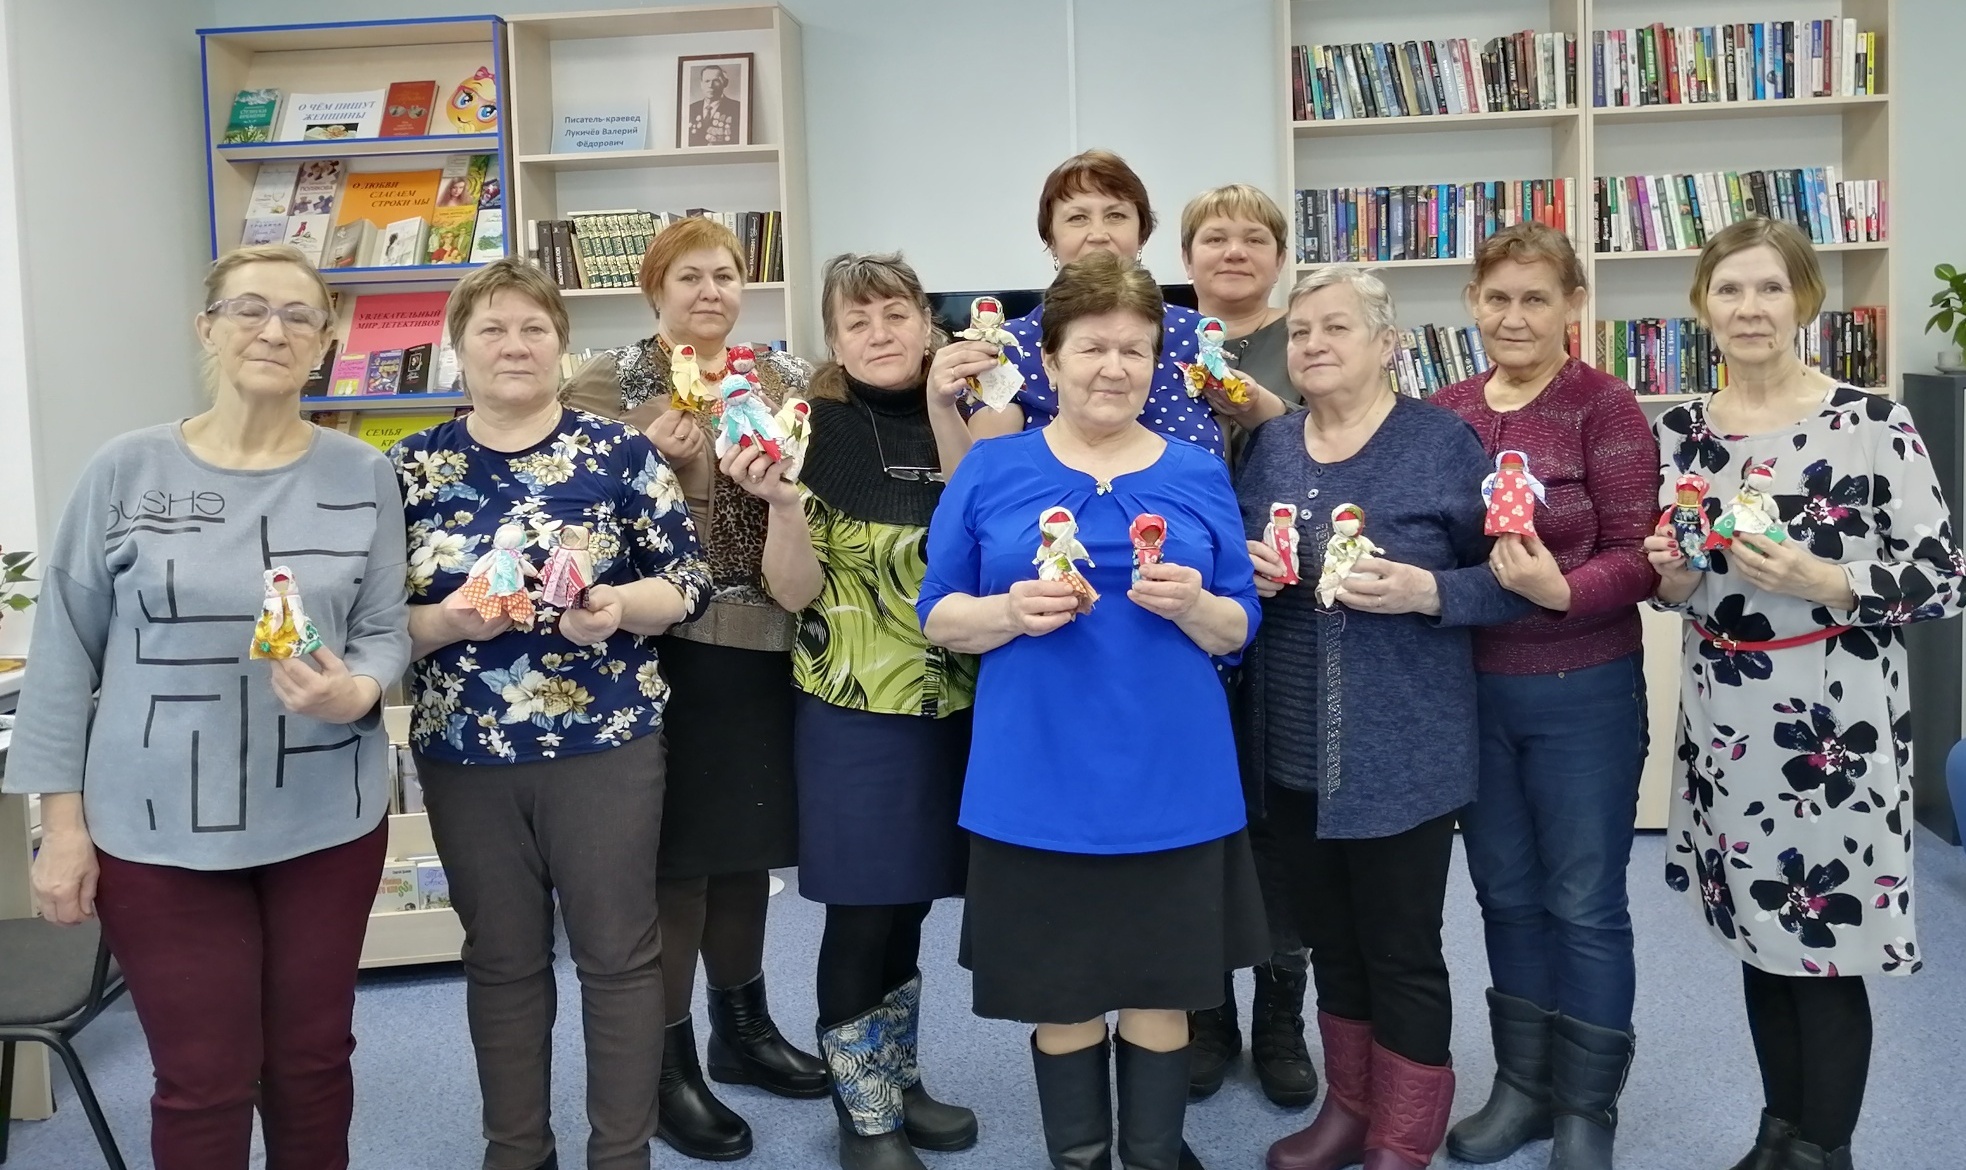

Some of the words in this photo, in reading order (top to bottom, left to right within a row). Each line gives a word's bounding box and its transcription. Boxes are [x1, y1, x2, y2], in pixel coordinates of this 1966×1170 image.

[334, 101, 376, 110] ПИШУТ
[302, 112, 366, 121] ЖЕНЩИНЫ
[564, 115, 641, 124] Писатель-краевед
[565, 129, 600, 138] Лукичёв
[602, 126, 638, 136] Валерий
[576, 140, 624, 149] Фёдорович
[361, 181, 399, 190] ЛЮБВИ
[369, 190, 416, 199] СЛАГАЕМ
[371, 200, 411, 208] СТРОКИ
[413, 198, 430, 206] МЫ
[359, 310, 441, 320] УВЛЕКАТЕЛЬНЫЙ
[378, 320, 440, 329] ДЕТЕКТИВОВ
[365, 428, 402, 436] СЕМЬЯ
